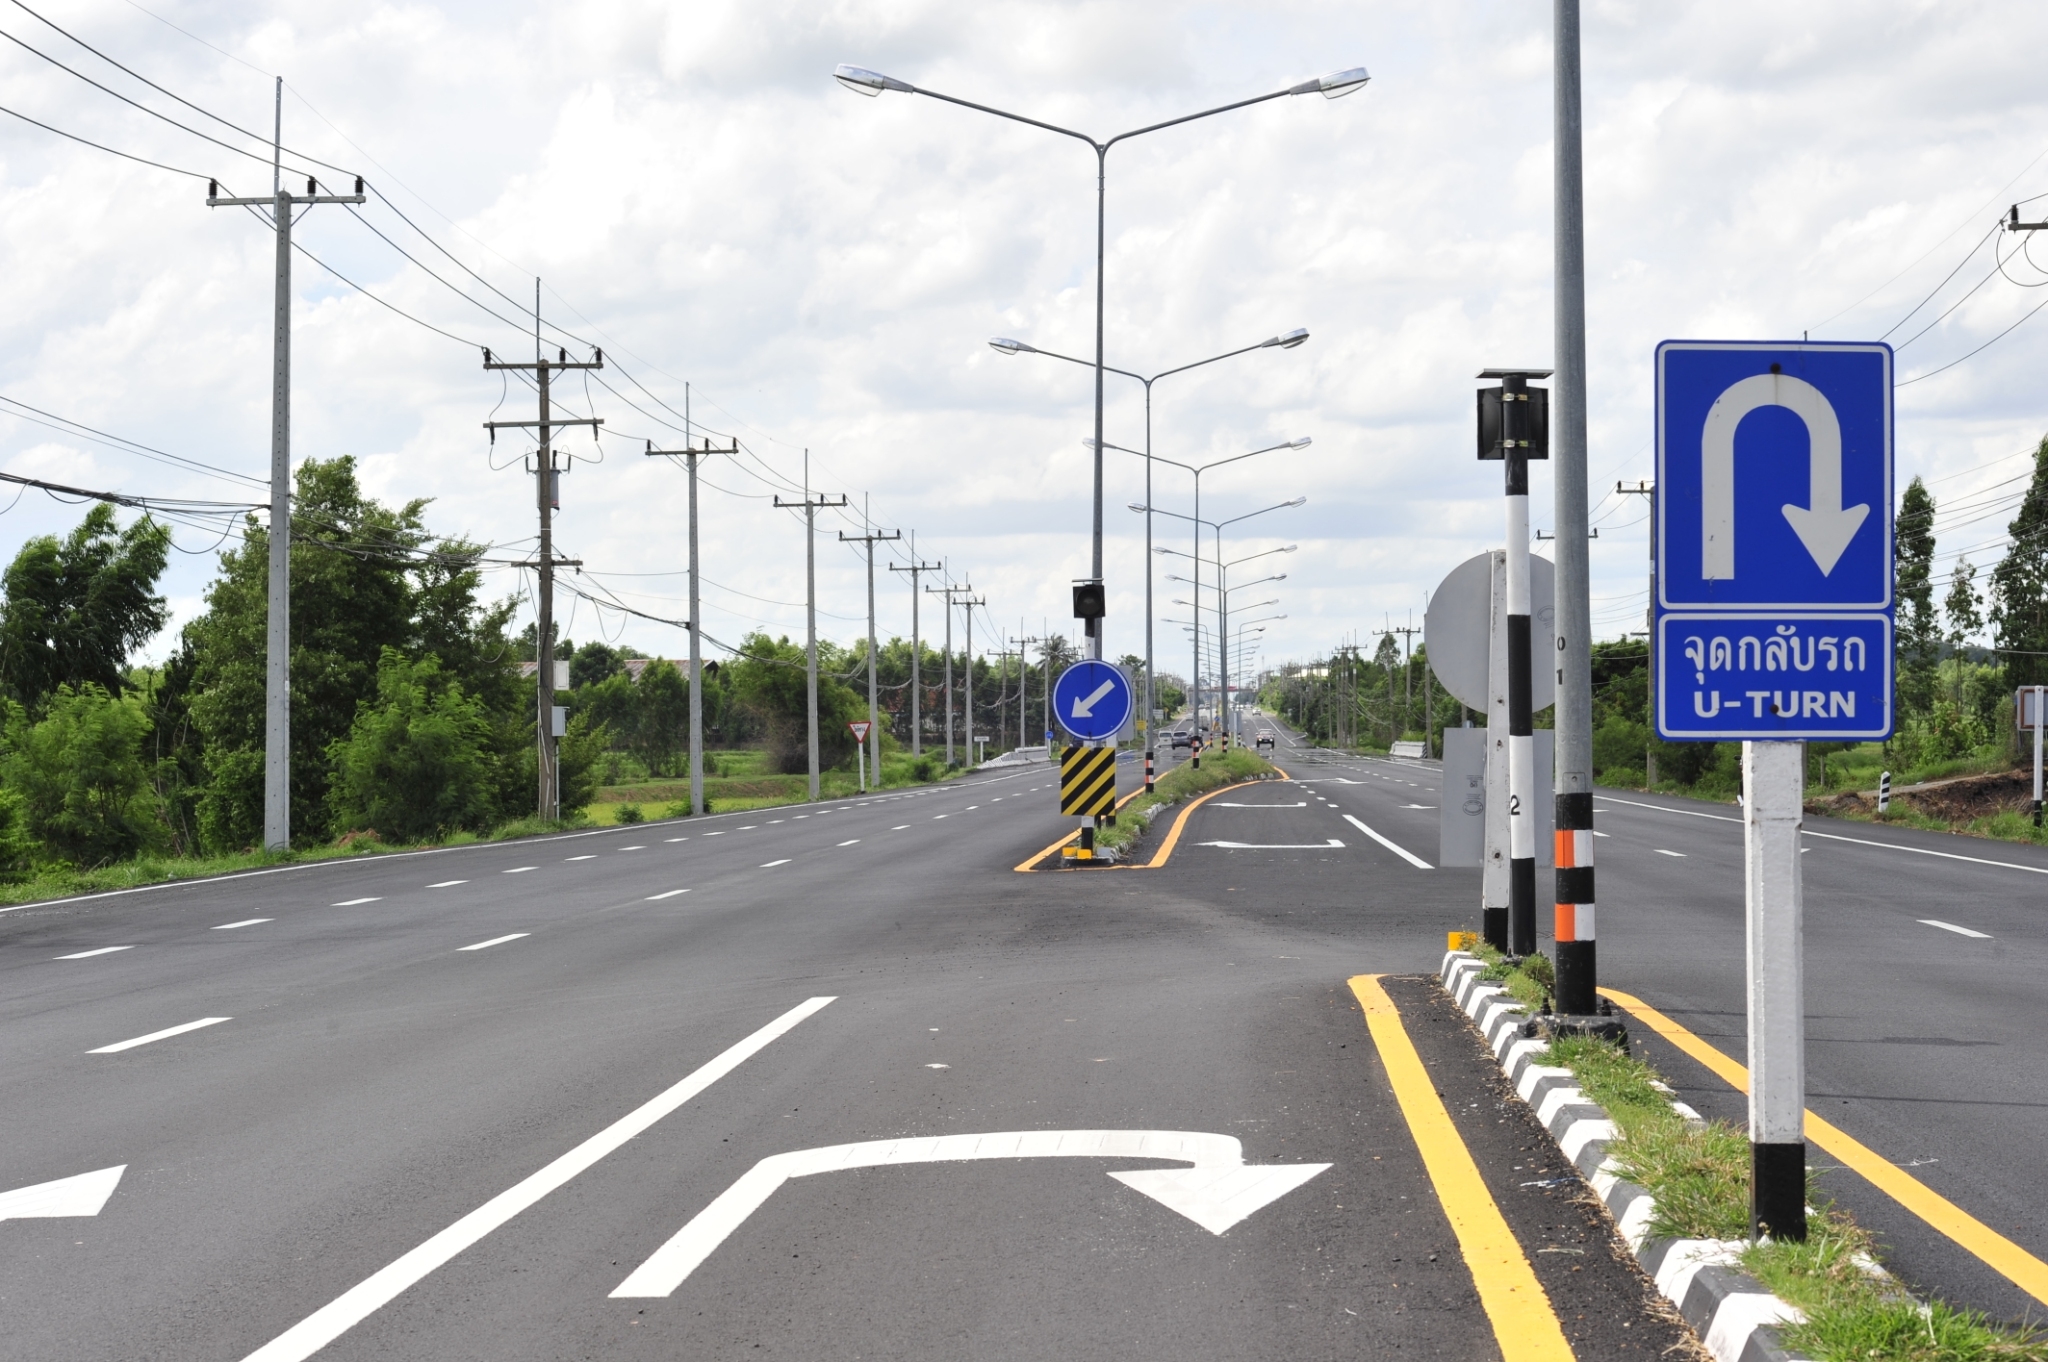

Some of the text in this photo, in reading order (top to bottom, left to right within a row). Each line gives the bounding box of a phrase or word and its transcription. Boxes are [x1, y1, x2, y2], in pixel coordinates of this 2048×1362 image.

[1684, 624, 1866, 685] จุดกลับรถ
[1694, 690, 1856, 718] U-TURN
[1510, 794, 1520, 815] 2
